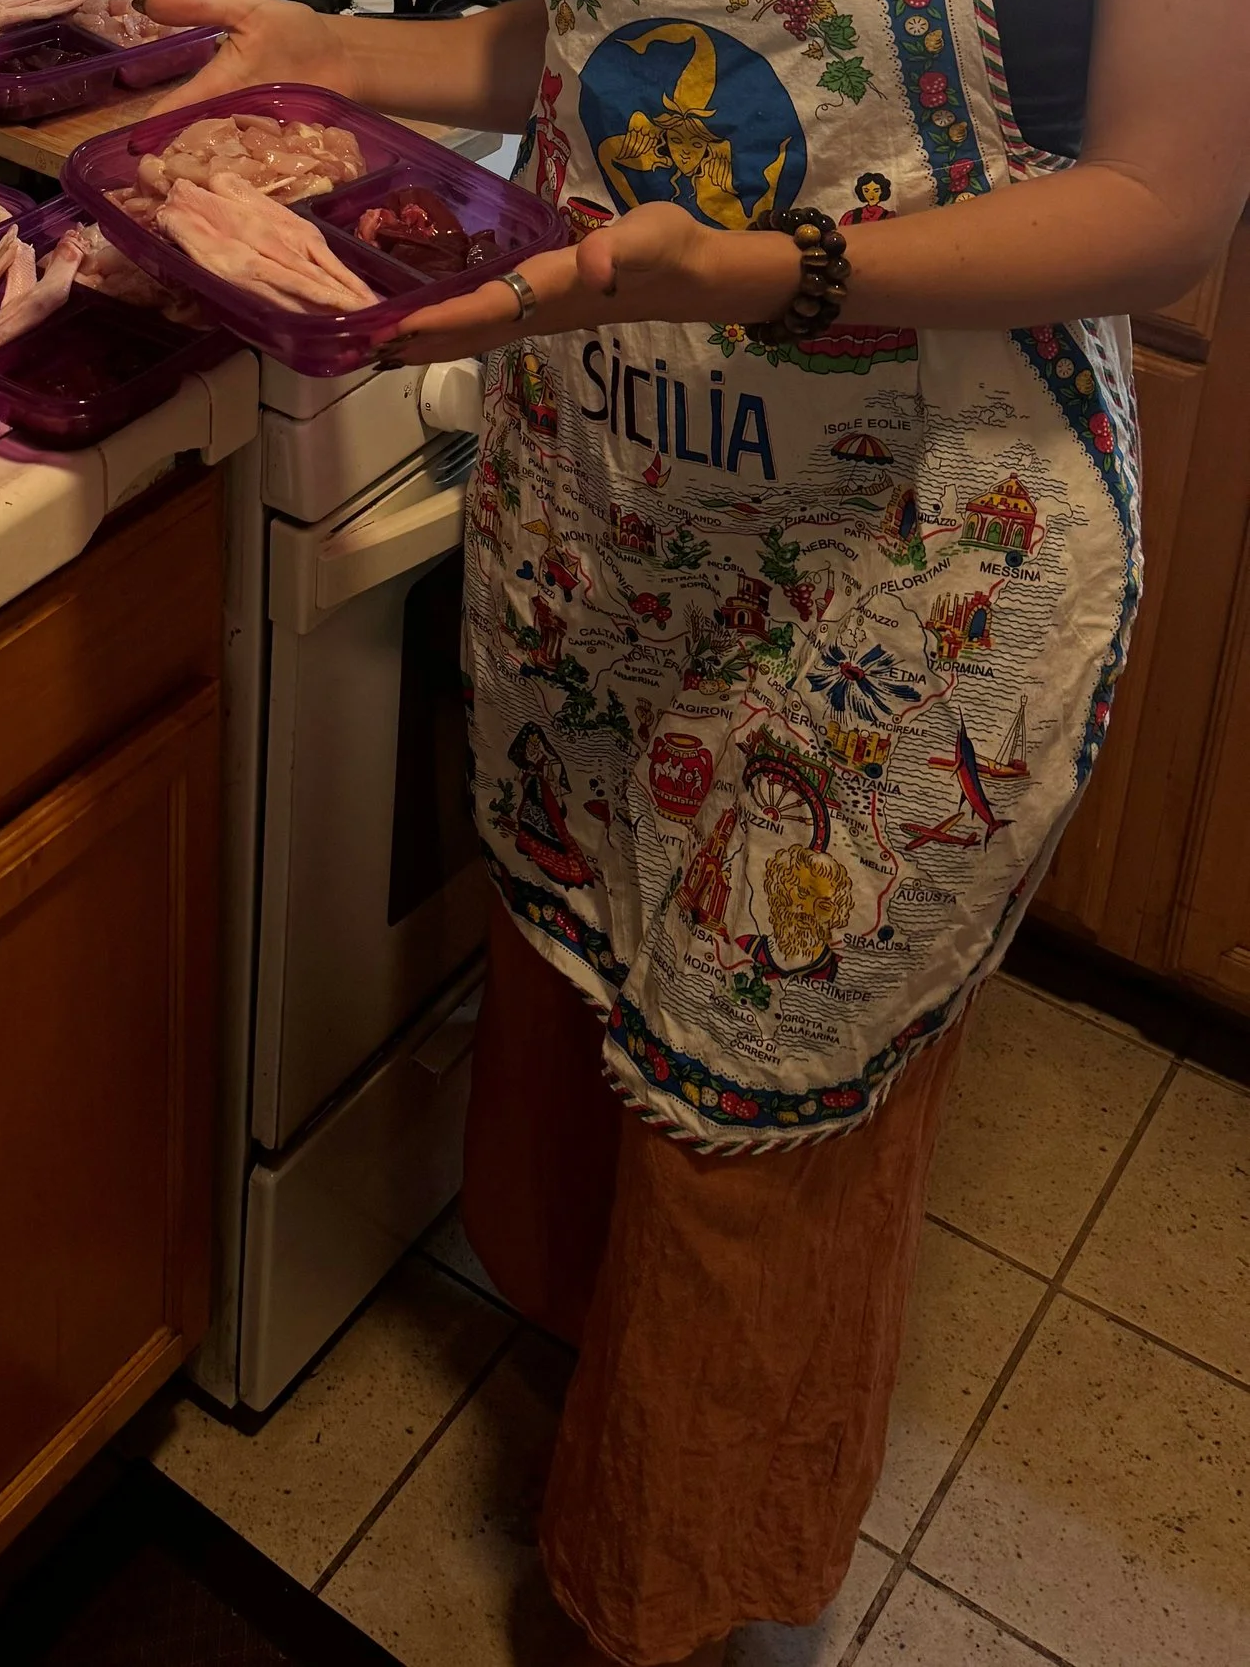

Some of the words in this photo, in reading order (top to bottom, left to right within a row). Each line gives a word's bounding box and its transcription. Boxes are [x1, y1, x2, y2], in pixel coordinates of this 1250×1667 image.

[824, 417, 863, 435] ISOLE
[866, 418, 912, 432] EOLIE
[784, 511, 842, 526] PIRAINO
[801, 537, 860, 562] NEBRODI
[879, 557, 952, 595] PELORITANI
[979, 560, 1042, 583] MESSINA
[889, 667, 928, 686] ETNA
[929, 659, 995, 678] TAORMINA
[841, 771, 902, 797] CATANIA
[829, 809, 869, 833] LENTINI
[897, 890, 957, 905] AUGUSTA
[842, 933, 912, 952] SIRACUSA
[790, 974, 872, 1002] ARCHIMEDE
[783, 1013, 824, 1030] GROTTA
[729, 1039, 781, 1066] CORRENTI
[737, 1031, 764, 1048] CAPO
[765, 1043, 777, 1054] DI
